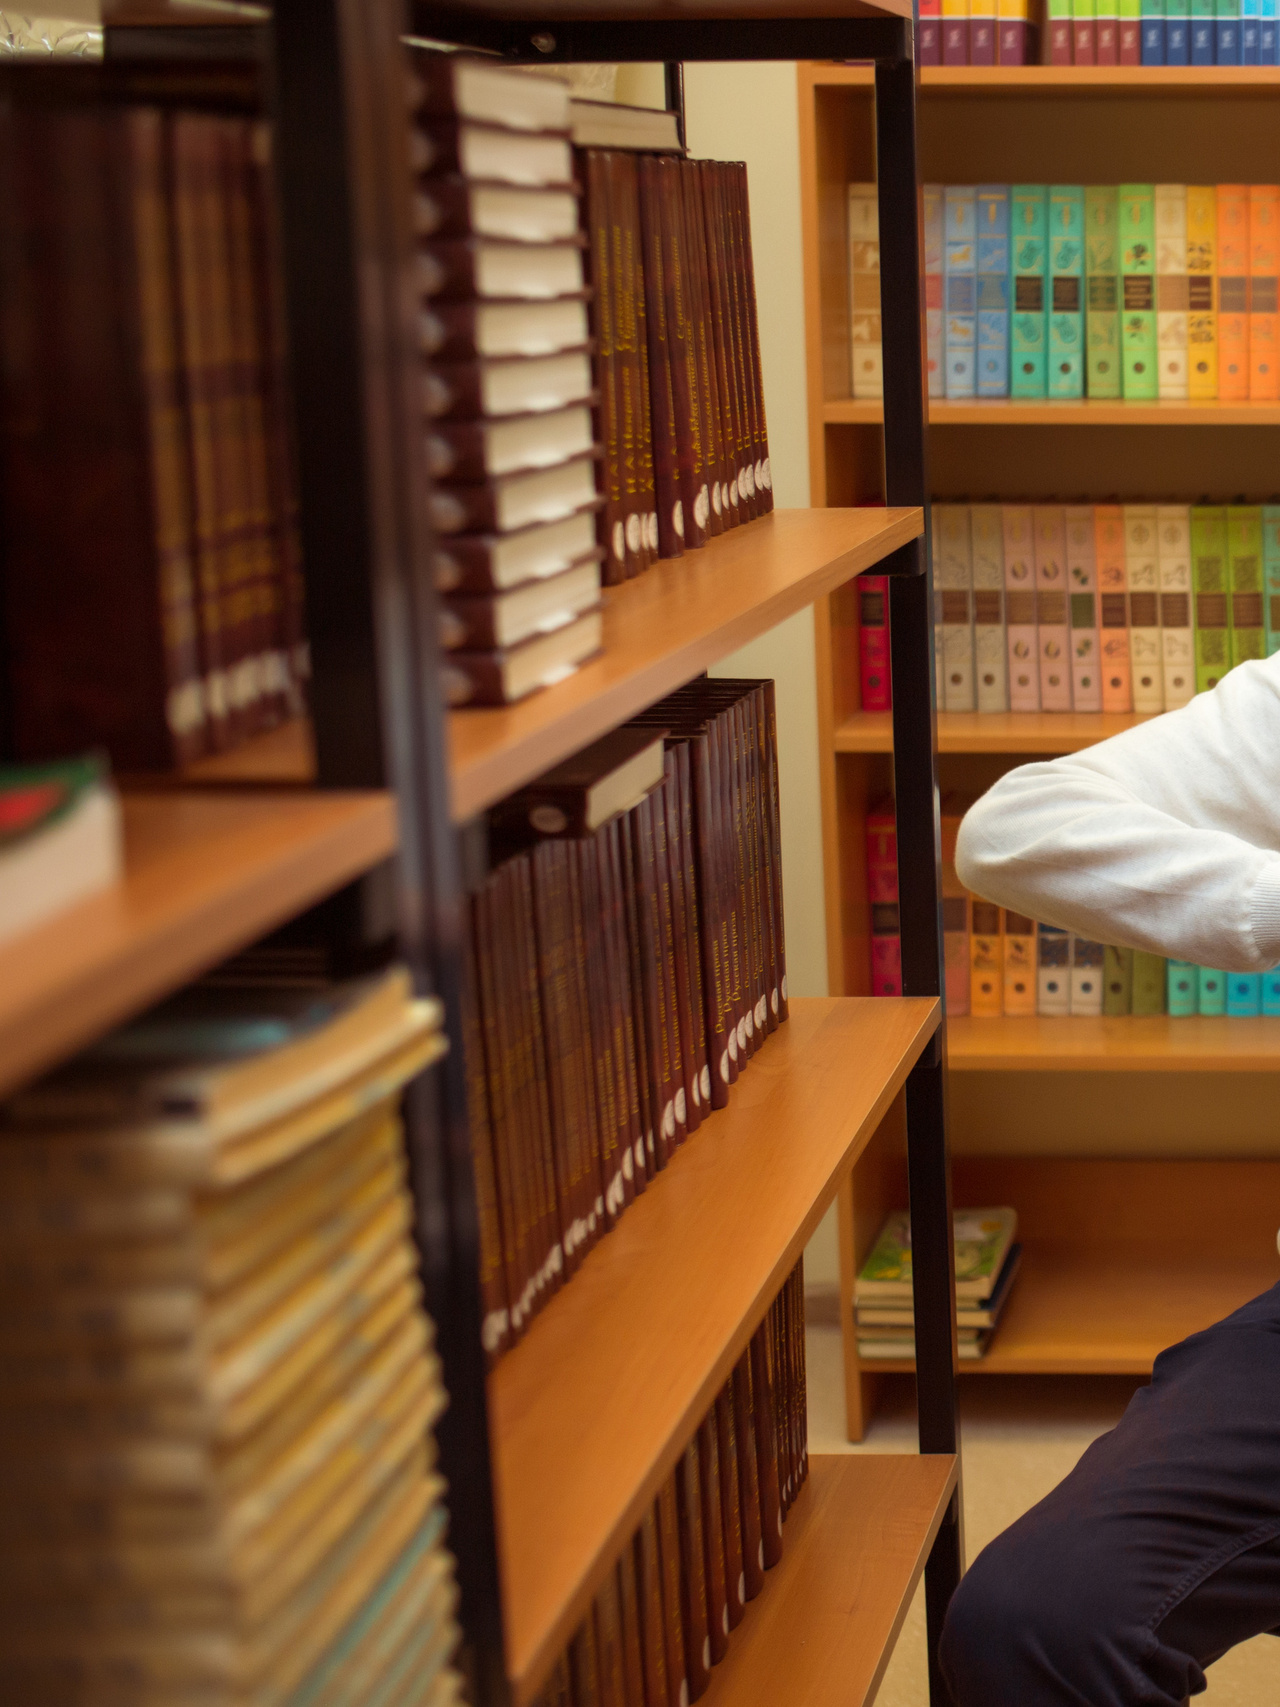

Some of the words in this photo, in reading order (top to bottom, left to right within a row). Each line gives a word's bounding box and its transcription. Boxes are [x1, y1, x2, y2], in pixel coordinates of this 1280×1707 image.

[721, 919, 730, 957] проза
[730, 910, 738, 947] проза
[712, 939, 721, 977] проза
[732, 949, 742, 1002] Русская
[715, 979, 725, 1034] Русская
[723, 960, 733, 1013] Русская
